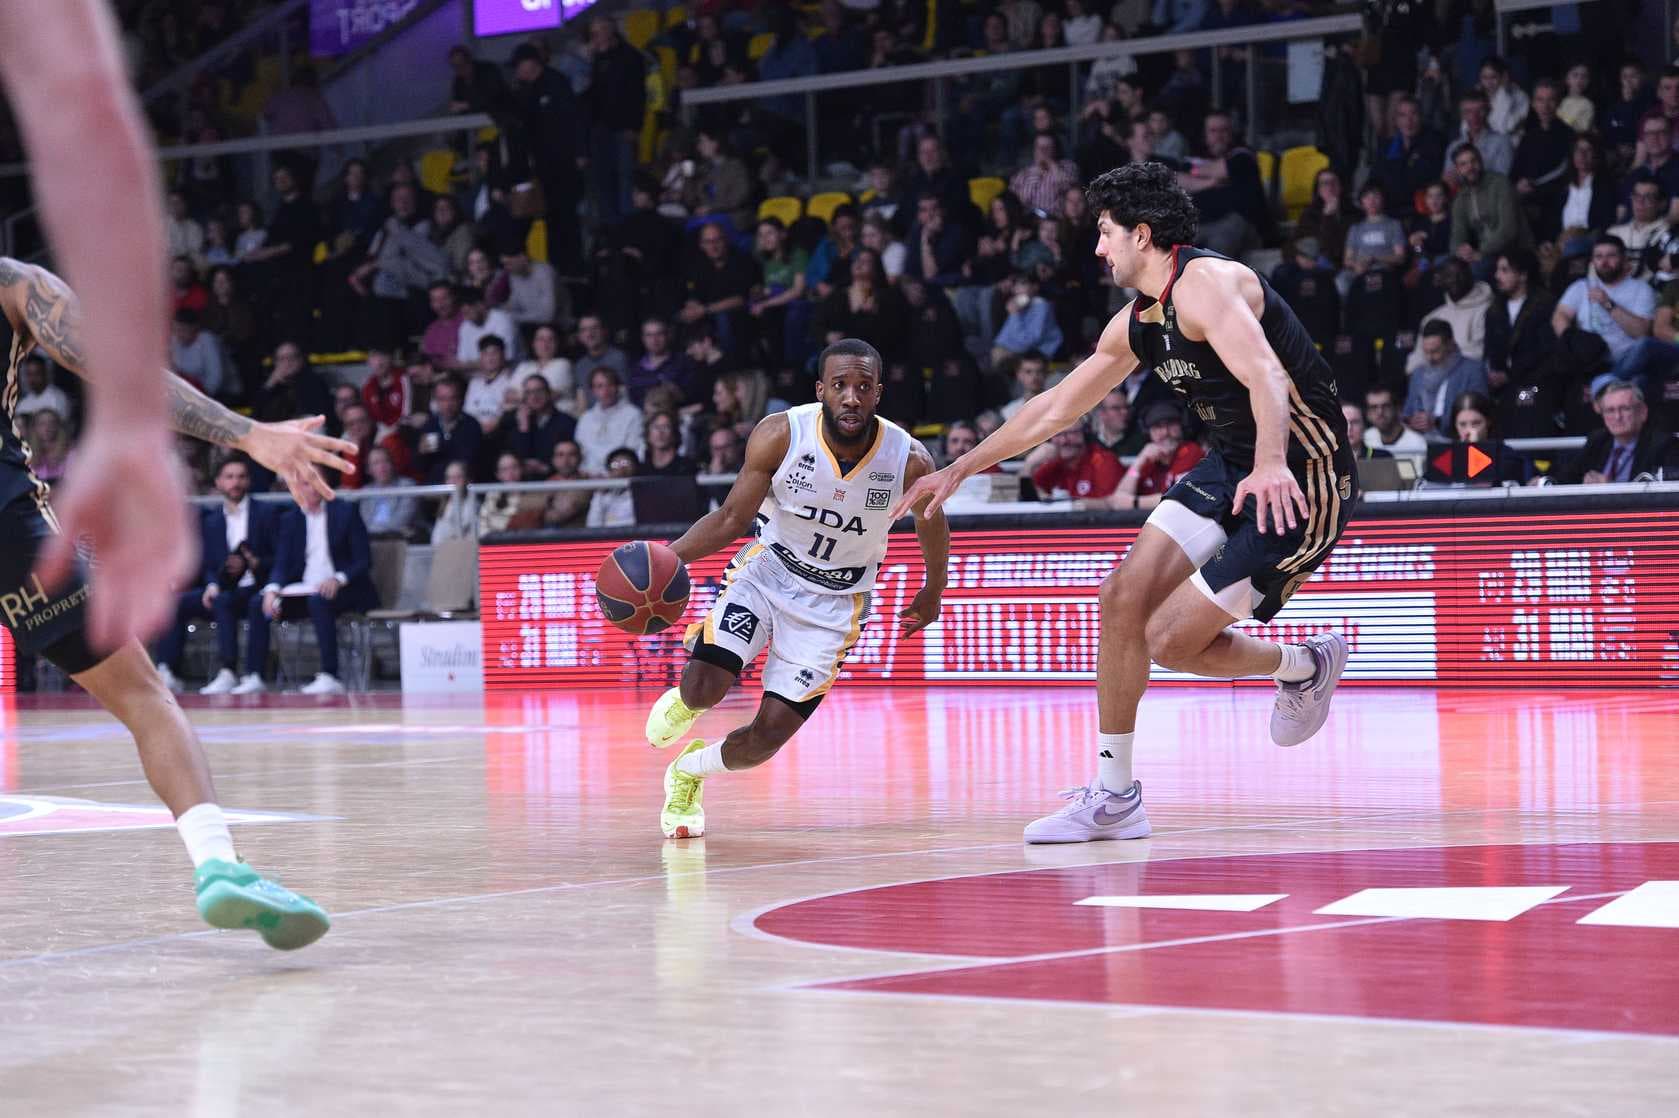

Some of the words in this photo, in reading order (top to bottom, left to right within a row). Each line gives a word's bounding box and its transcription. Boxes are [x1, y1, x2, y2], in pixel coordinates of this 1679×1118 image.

[870, 491, 889, 501] 100
[808, 532, 838, 562] 11
[0, 573, 48, 629] RH
[944, 604, 1096, 670] BILLETTERI
